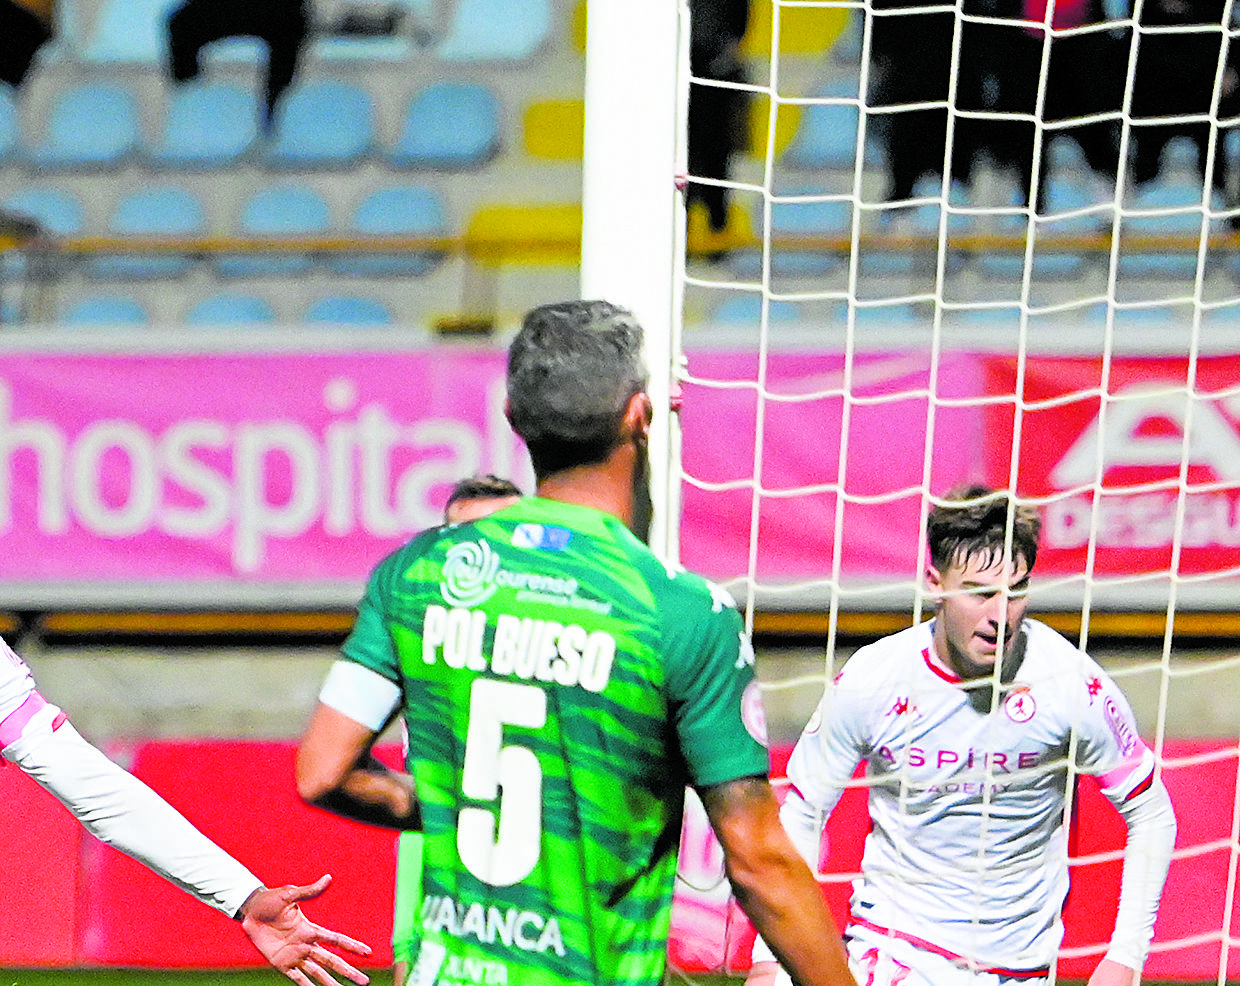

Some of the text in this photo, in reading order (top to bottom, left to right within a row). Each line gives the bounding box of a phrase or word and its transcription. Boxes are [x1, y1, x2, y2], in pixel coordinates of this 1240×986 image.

[422, 604, 616, 693] POL BUESO
[456, 677, 548, 887] 5
